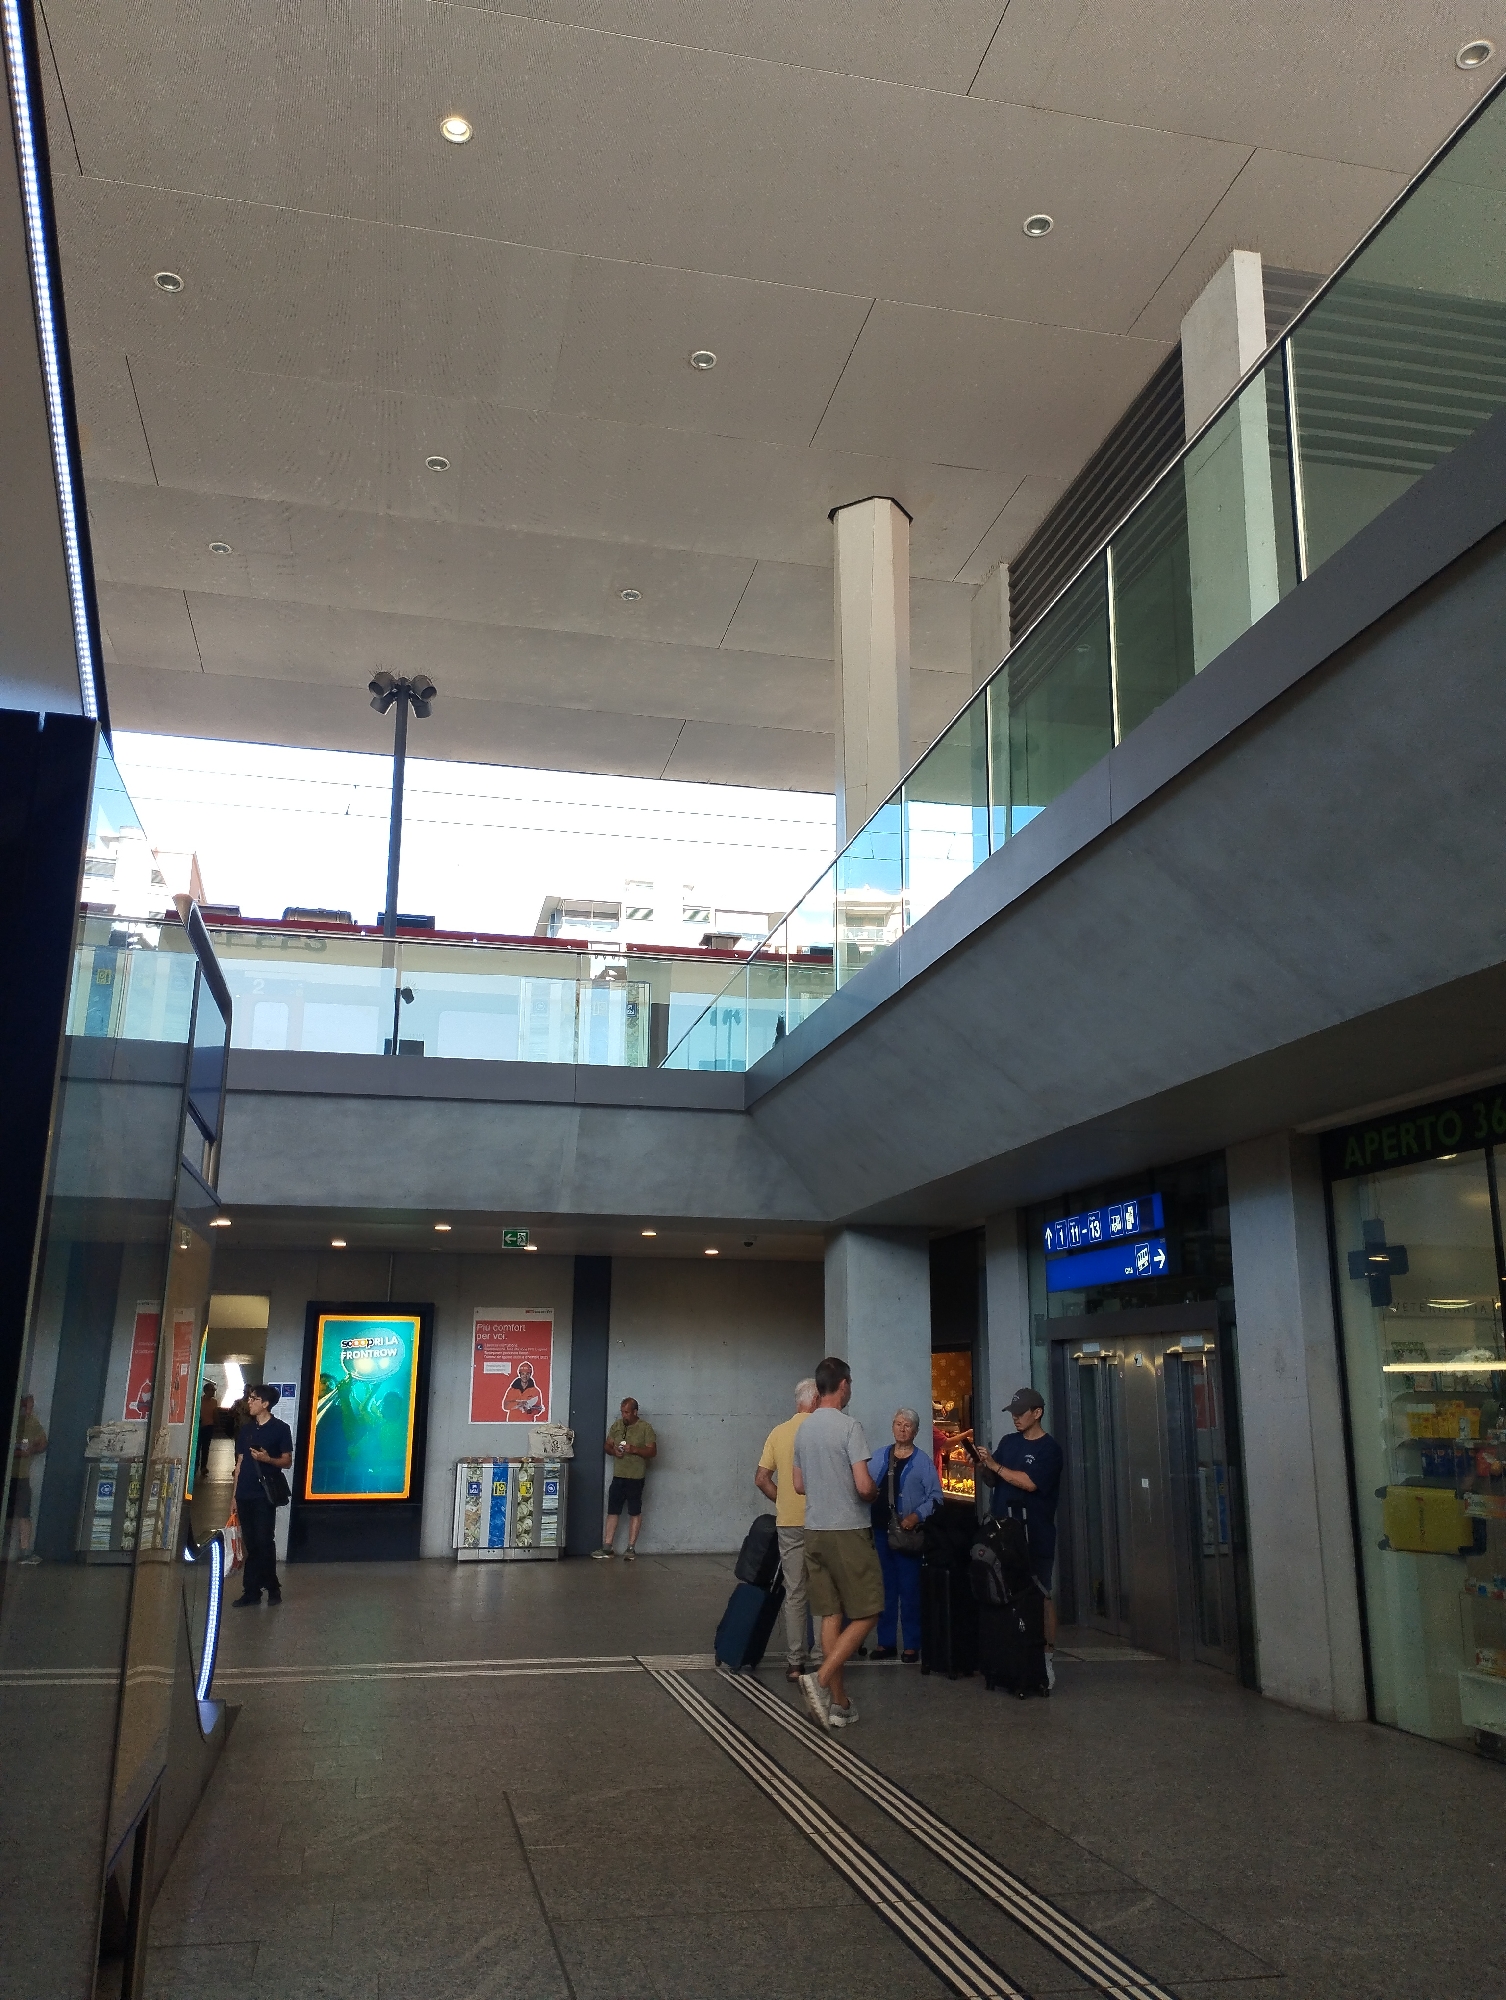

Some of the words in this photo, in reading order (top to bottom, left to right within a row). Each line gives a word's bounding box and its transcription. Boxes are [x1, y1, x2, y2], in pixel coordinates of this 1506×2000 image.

[252, 979, 265, 995] 2
[1344, 1110, 1463, 1170] APERTO
[1070, 1225, 1079, 1243] 11
[1089, 1220, 1101, 1239] 13
[493, 1323, 527, 1332] comfort
[385, 1335, 399, 1345] LA
[476, 1332, 491, 1341] per
[341, 1347, 398, 1360] FRONTROW
